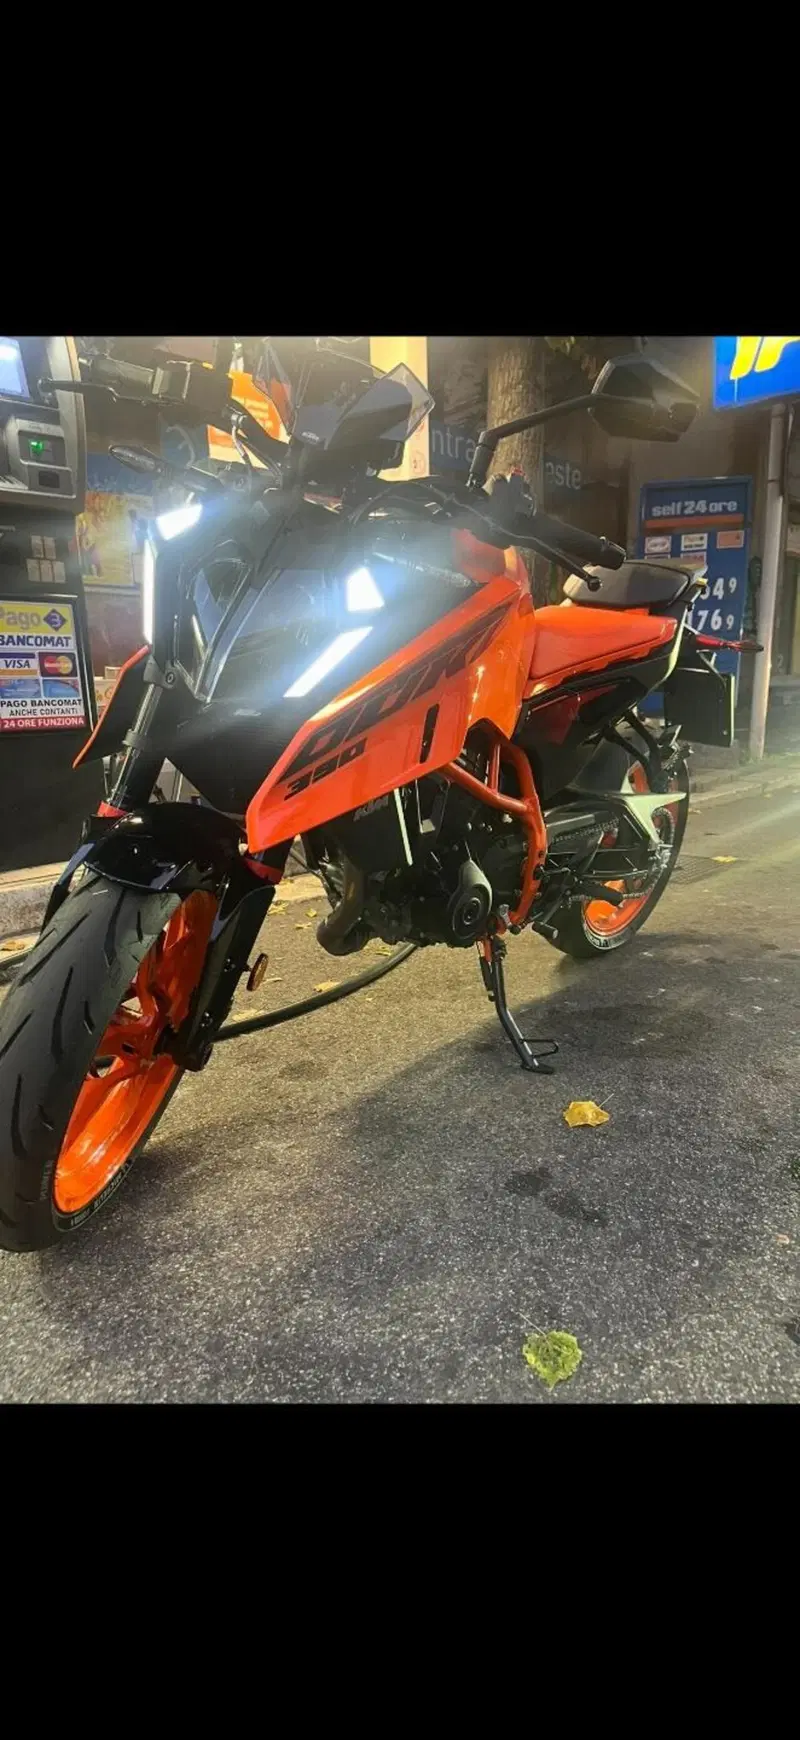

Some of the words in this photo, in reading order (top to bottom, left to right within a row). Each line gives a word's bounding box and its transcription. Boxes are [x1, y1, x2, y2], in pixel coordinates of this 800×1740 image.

[652, 503, 682, 517] self
[684, 500, 707, 515] 24
[709, 500, 738, 513] ore
[4, 659, 31, 669] VISA
[31, 699, 82, 707] BANCOMAT
[9, 708, 37, 716] ANCHE
[40, 707, 78, 715] CONTANTI
[4, 719, 15, 728] 24
[18, 718, 36, 727] ORE
[38, 717, 84, 727] FUNZIONA
[284, 737, 368, 801] 390
